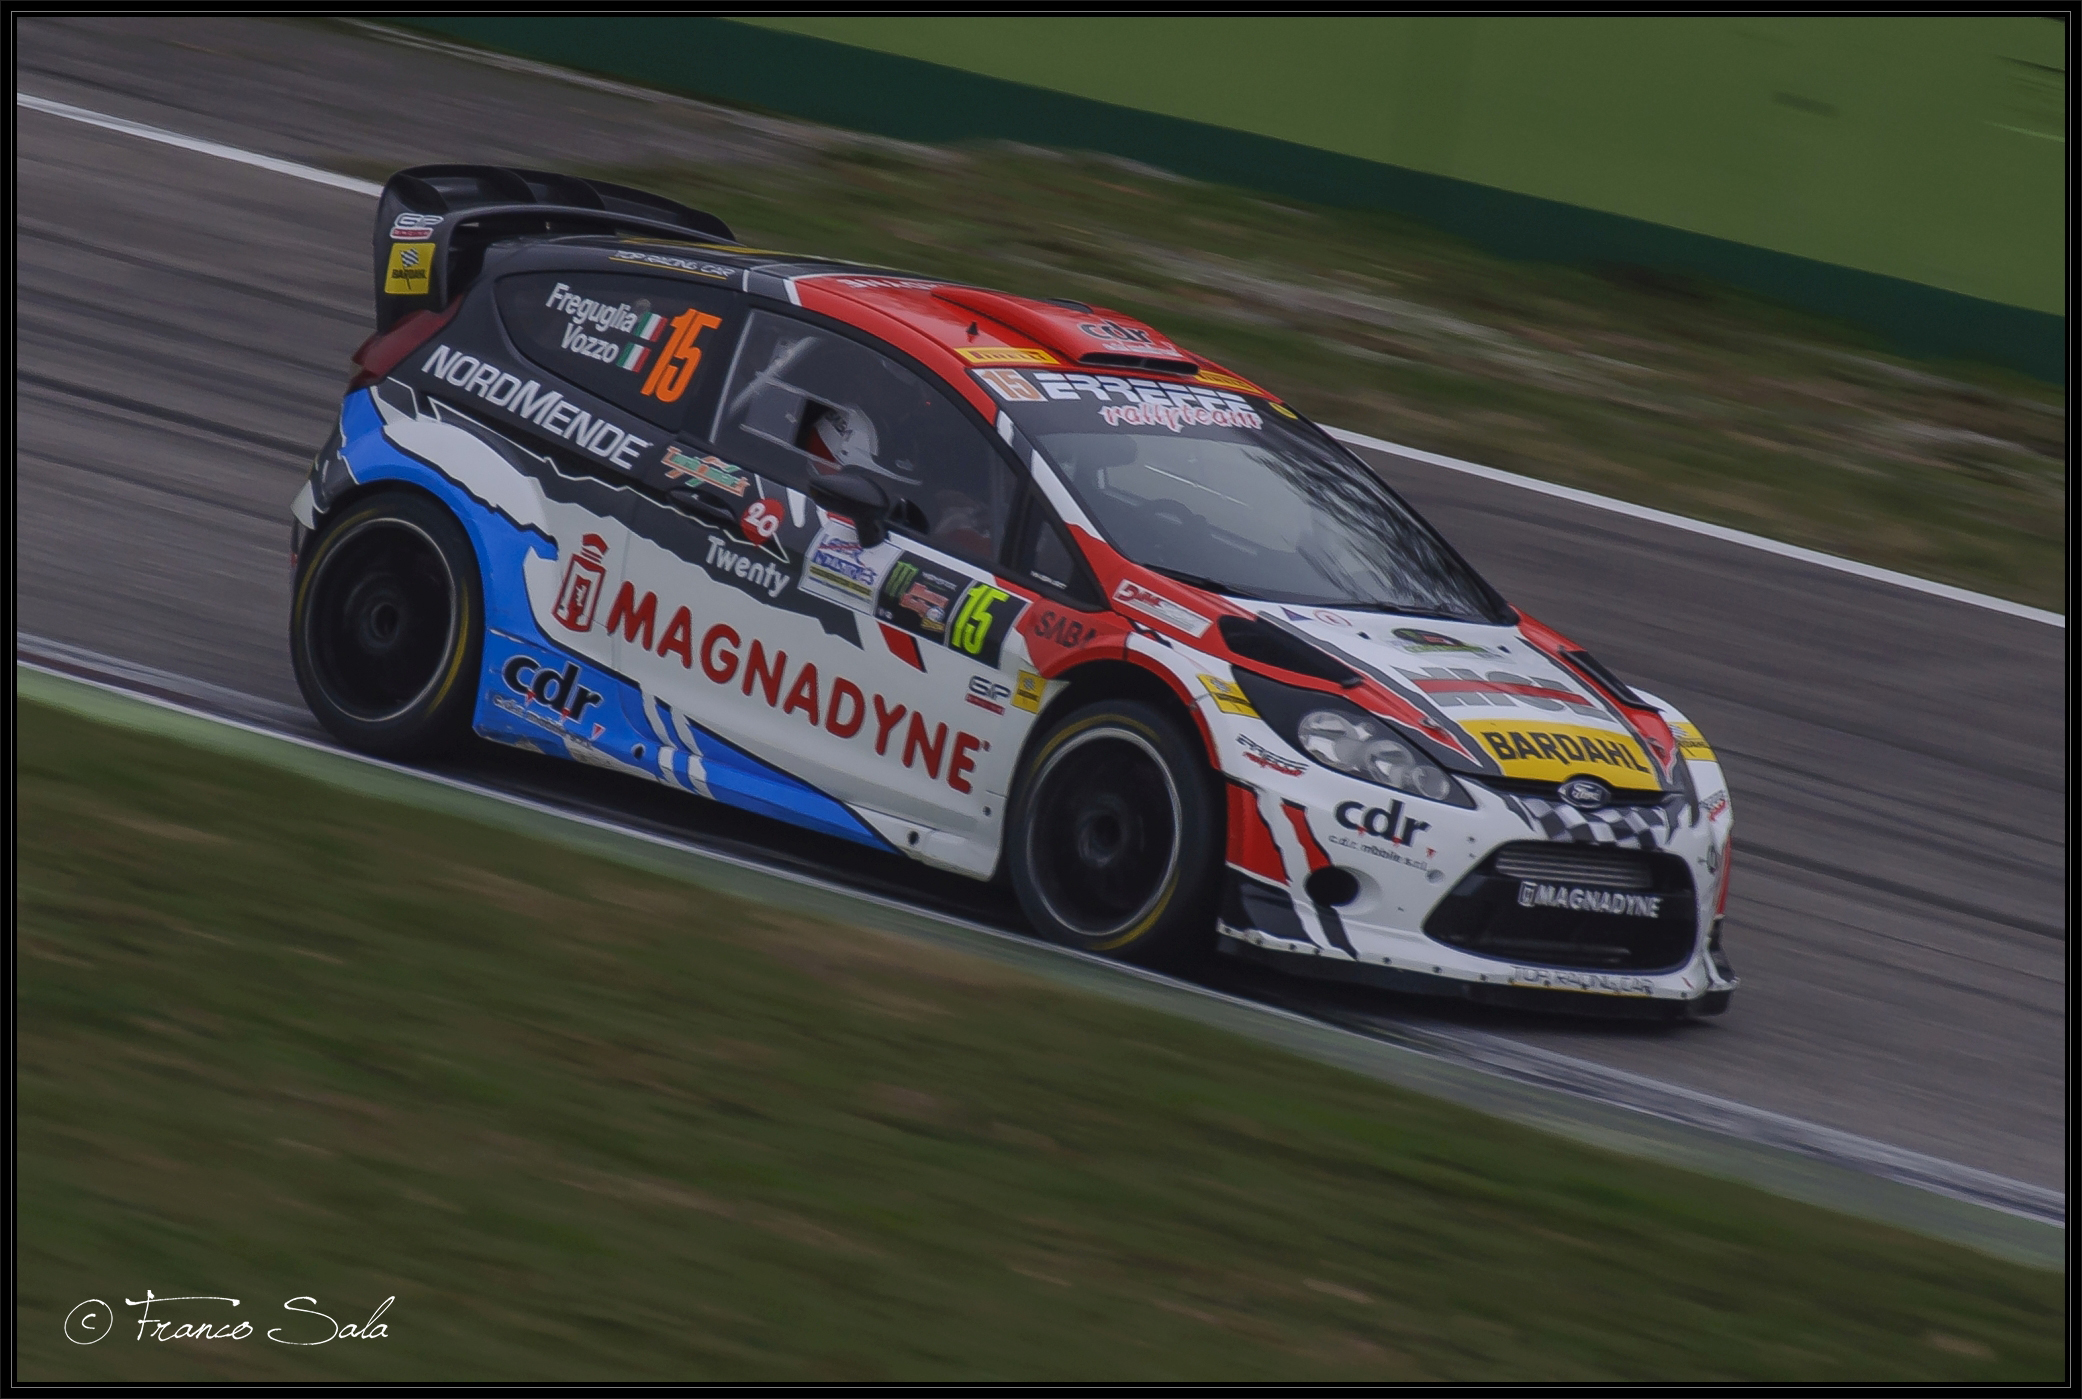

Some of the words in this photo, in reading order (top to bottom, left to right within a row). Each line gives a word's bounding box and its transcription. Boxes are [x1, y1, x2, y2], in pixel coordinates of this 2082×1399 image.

[545, 281, 638, 333] Freguglia
[1077, 318, 1153, 345] cdr
[560, 322, 620, 364] Vozzo
[640, 307, 723, 404] 15
[981, 369, 1042, 400] 15
[743, 501, 779, 538] 20
[705, 534, 791, 599] Twenty
[951, 583, 1011, 655] 15
[501, 654, 605, 725] cdr
[607, 580, 982, 795] MAGNADYNE
[1480, 731, 1654, 775] BARDAHL
[1333, 798, 1433, 848] cdr
[1534, 884, 1663, 919] MAGNADYNE
